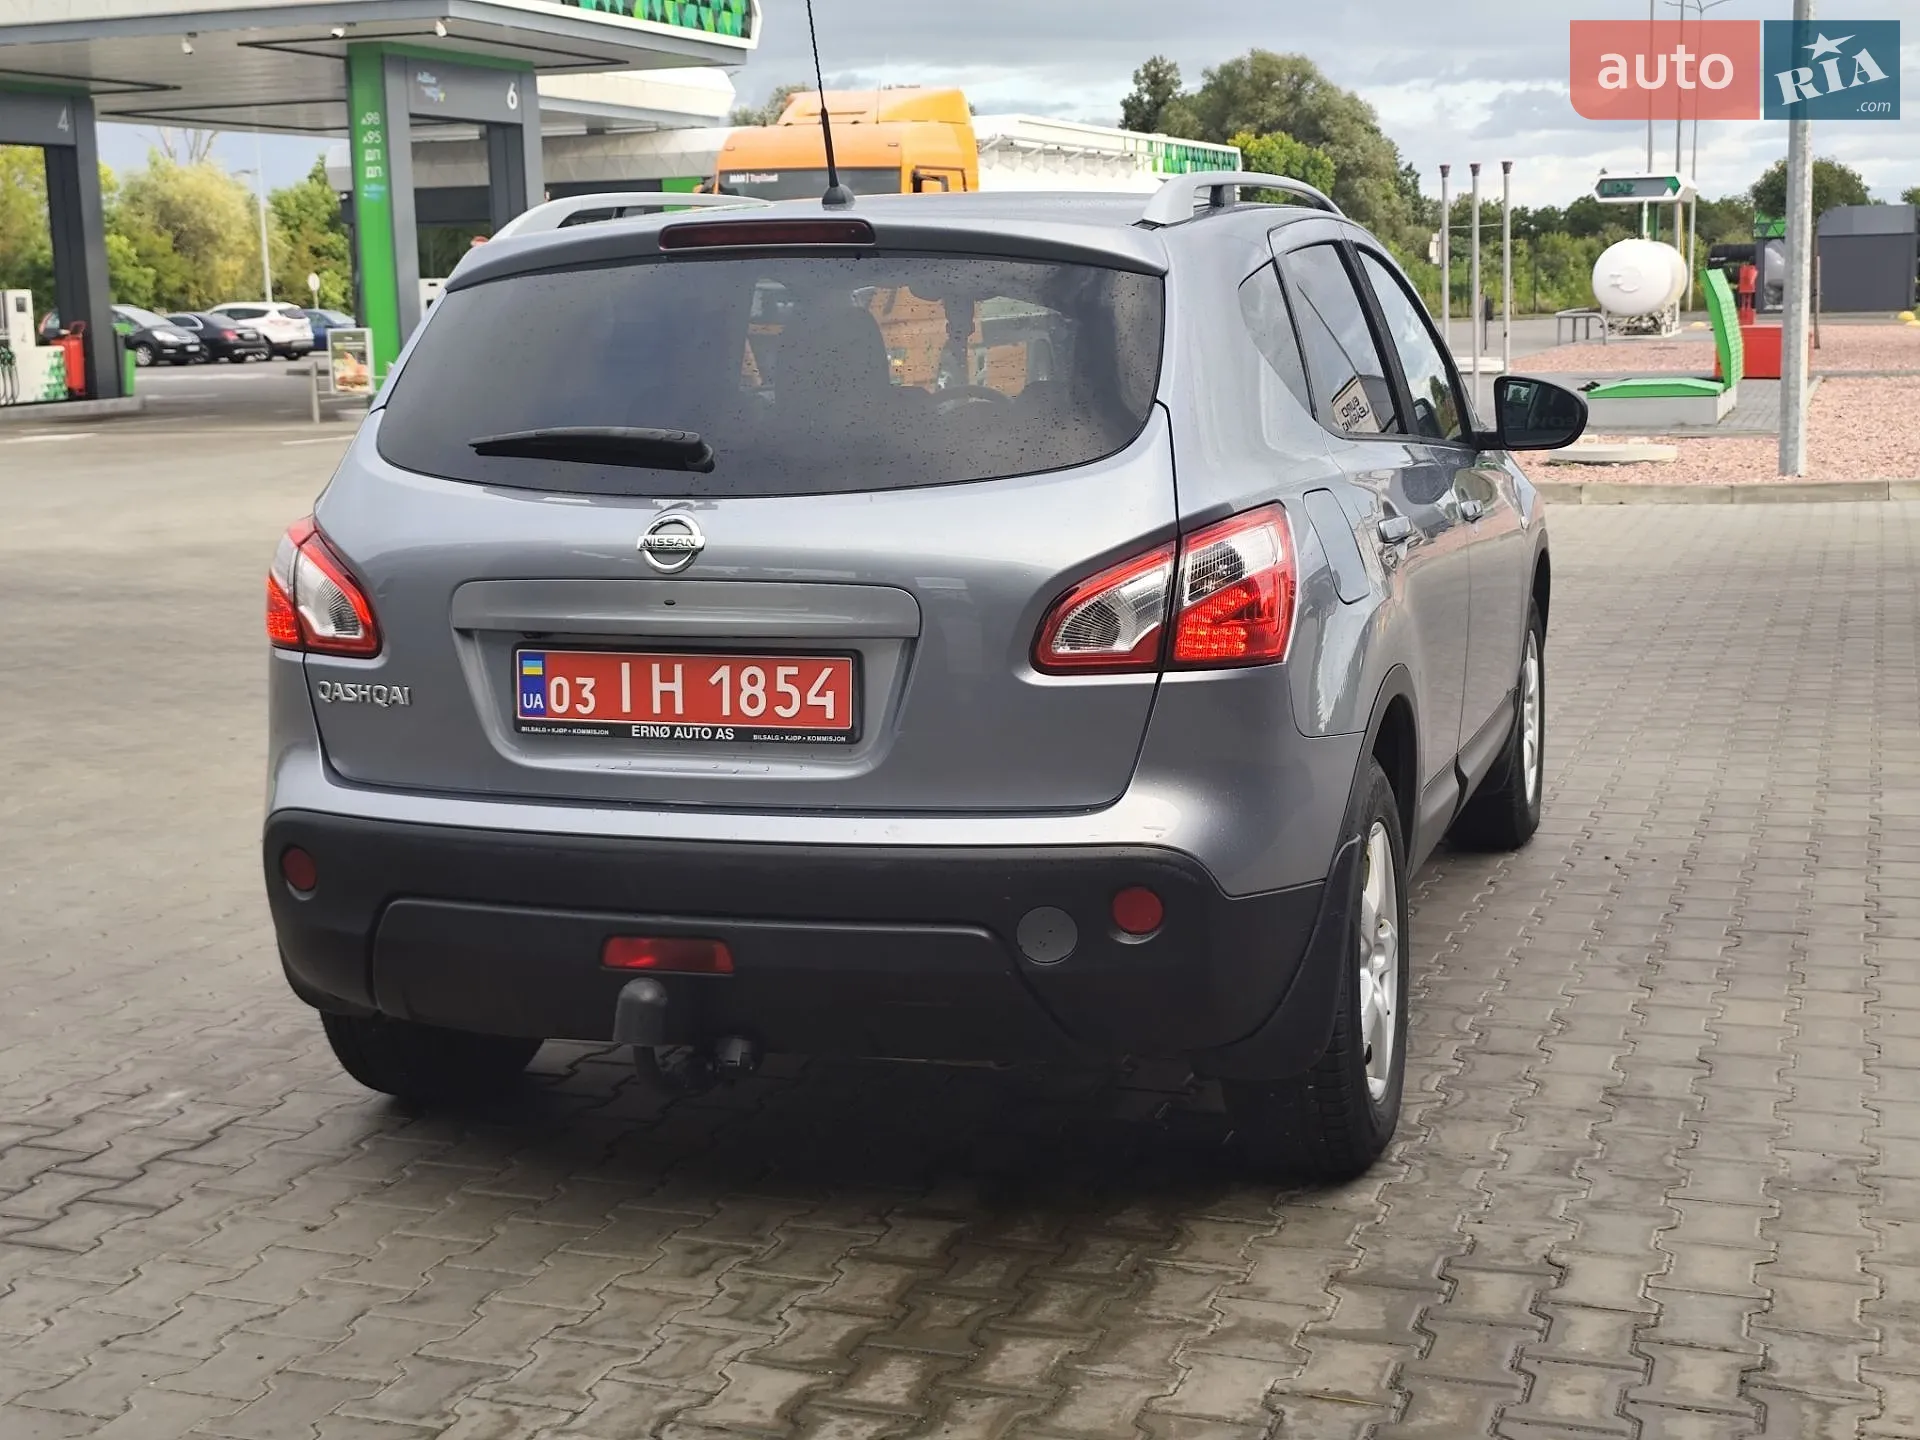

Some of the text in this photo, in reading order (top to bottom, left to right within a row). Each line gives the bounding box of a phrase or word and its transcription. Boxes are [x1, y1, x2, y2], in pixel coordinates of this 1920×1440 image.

[506, 82, 518, 110] 6
[57, 103, 69, 132] 4
[643, 537, 697, 547] NISSAN
[318, 680, 410, 707] QASHQAI
[523, 693, 544, 709] UA
[550, 676, 596, 714] 03
[708, 665, 835, 720] 1854
[631, 725, 735, 740] ERNØ AUTO AS
